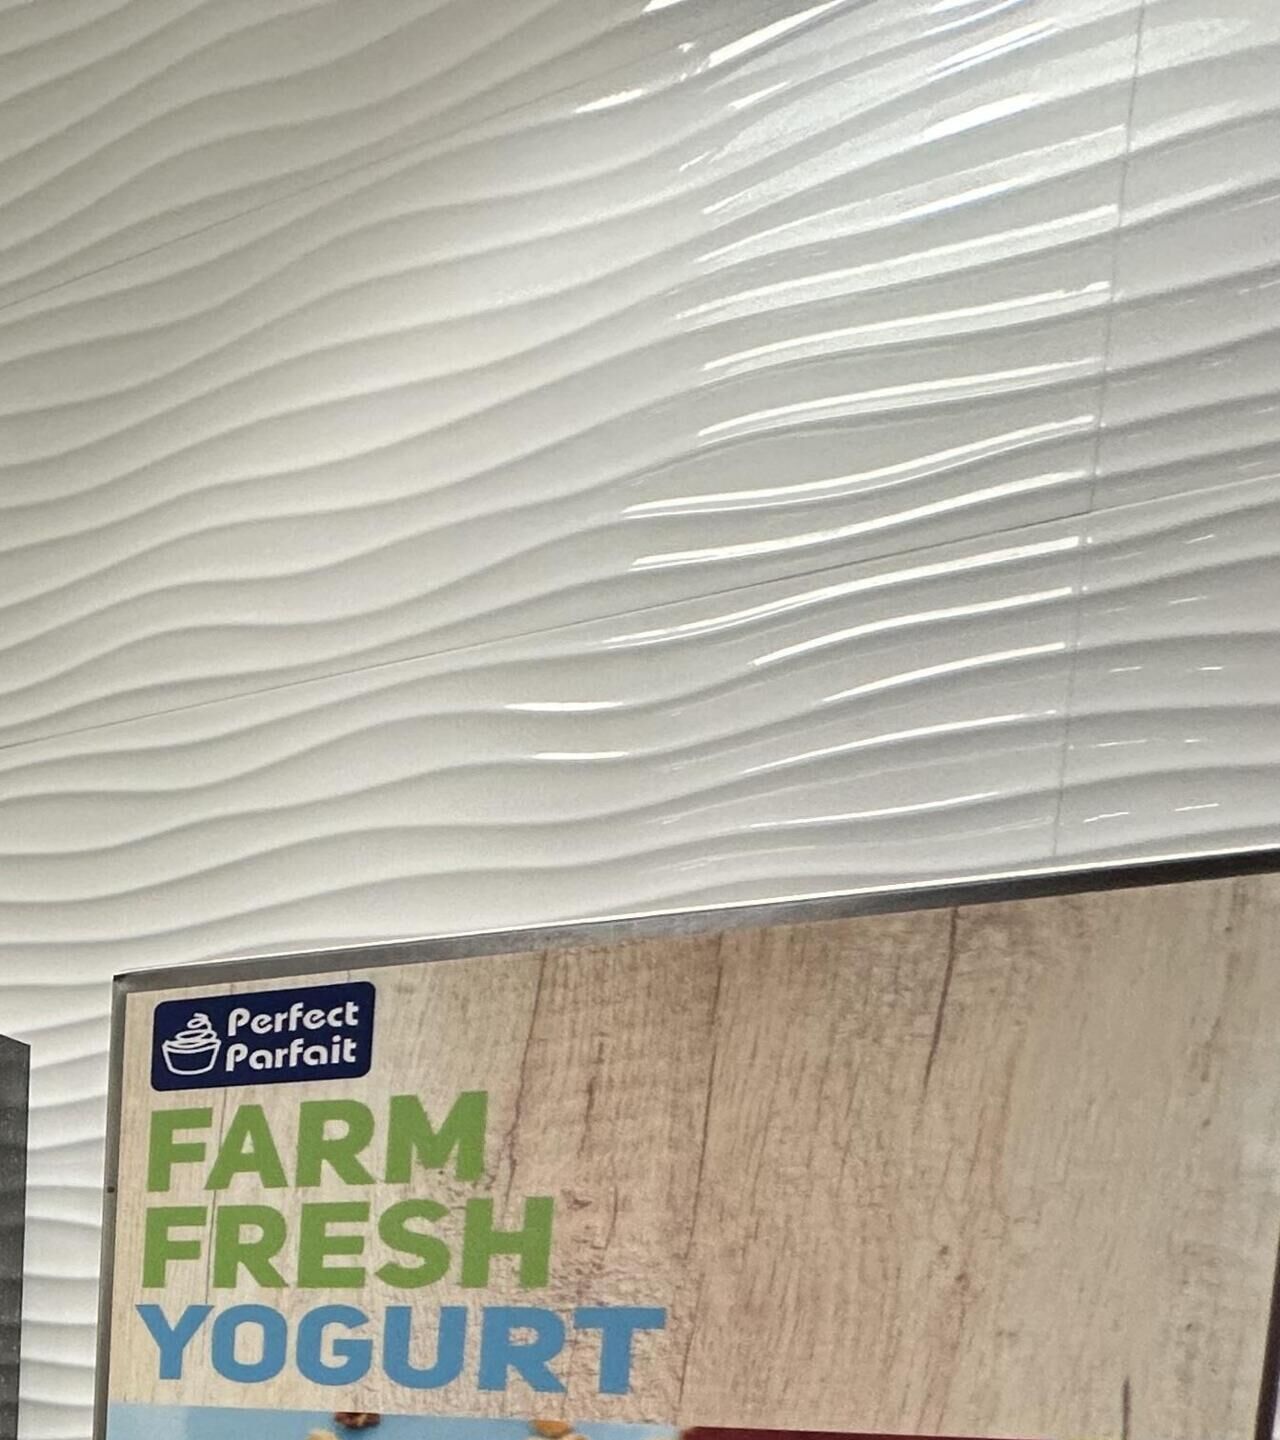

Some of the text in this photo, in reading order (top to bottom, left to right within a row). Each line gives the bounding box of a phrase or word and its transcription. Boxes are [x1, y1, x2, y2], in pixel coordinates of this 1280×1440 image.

[226, 1036, 357, 1073] Parfait
[228, 1001, 359, 1036] Perfect
[147, 1090, 489, 1193] FARM
[142, 1196, 554, 1290] FRESH
[135, 1303, 667, 1395] YOGURT
